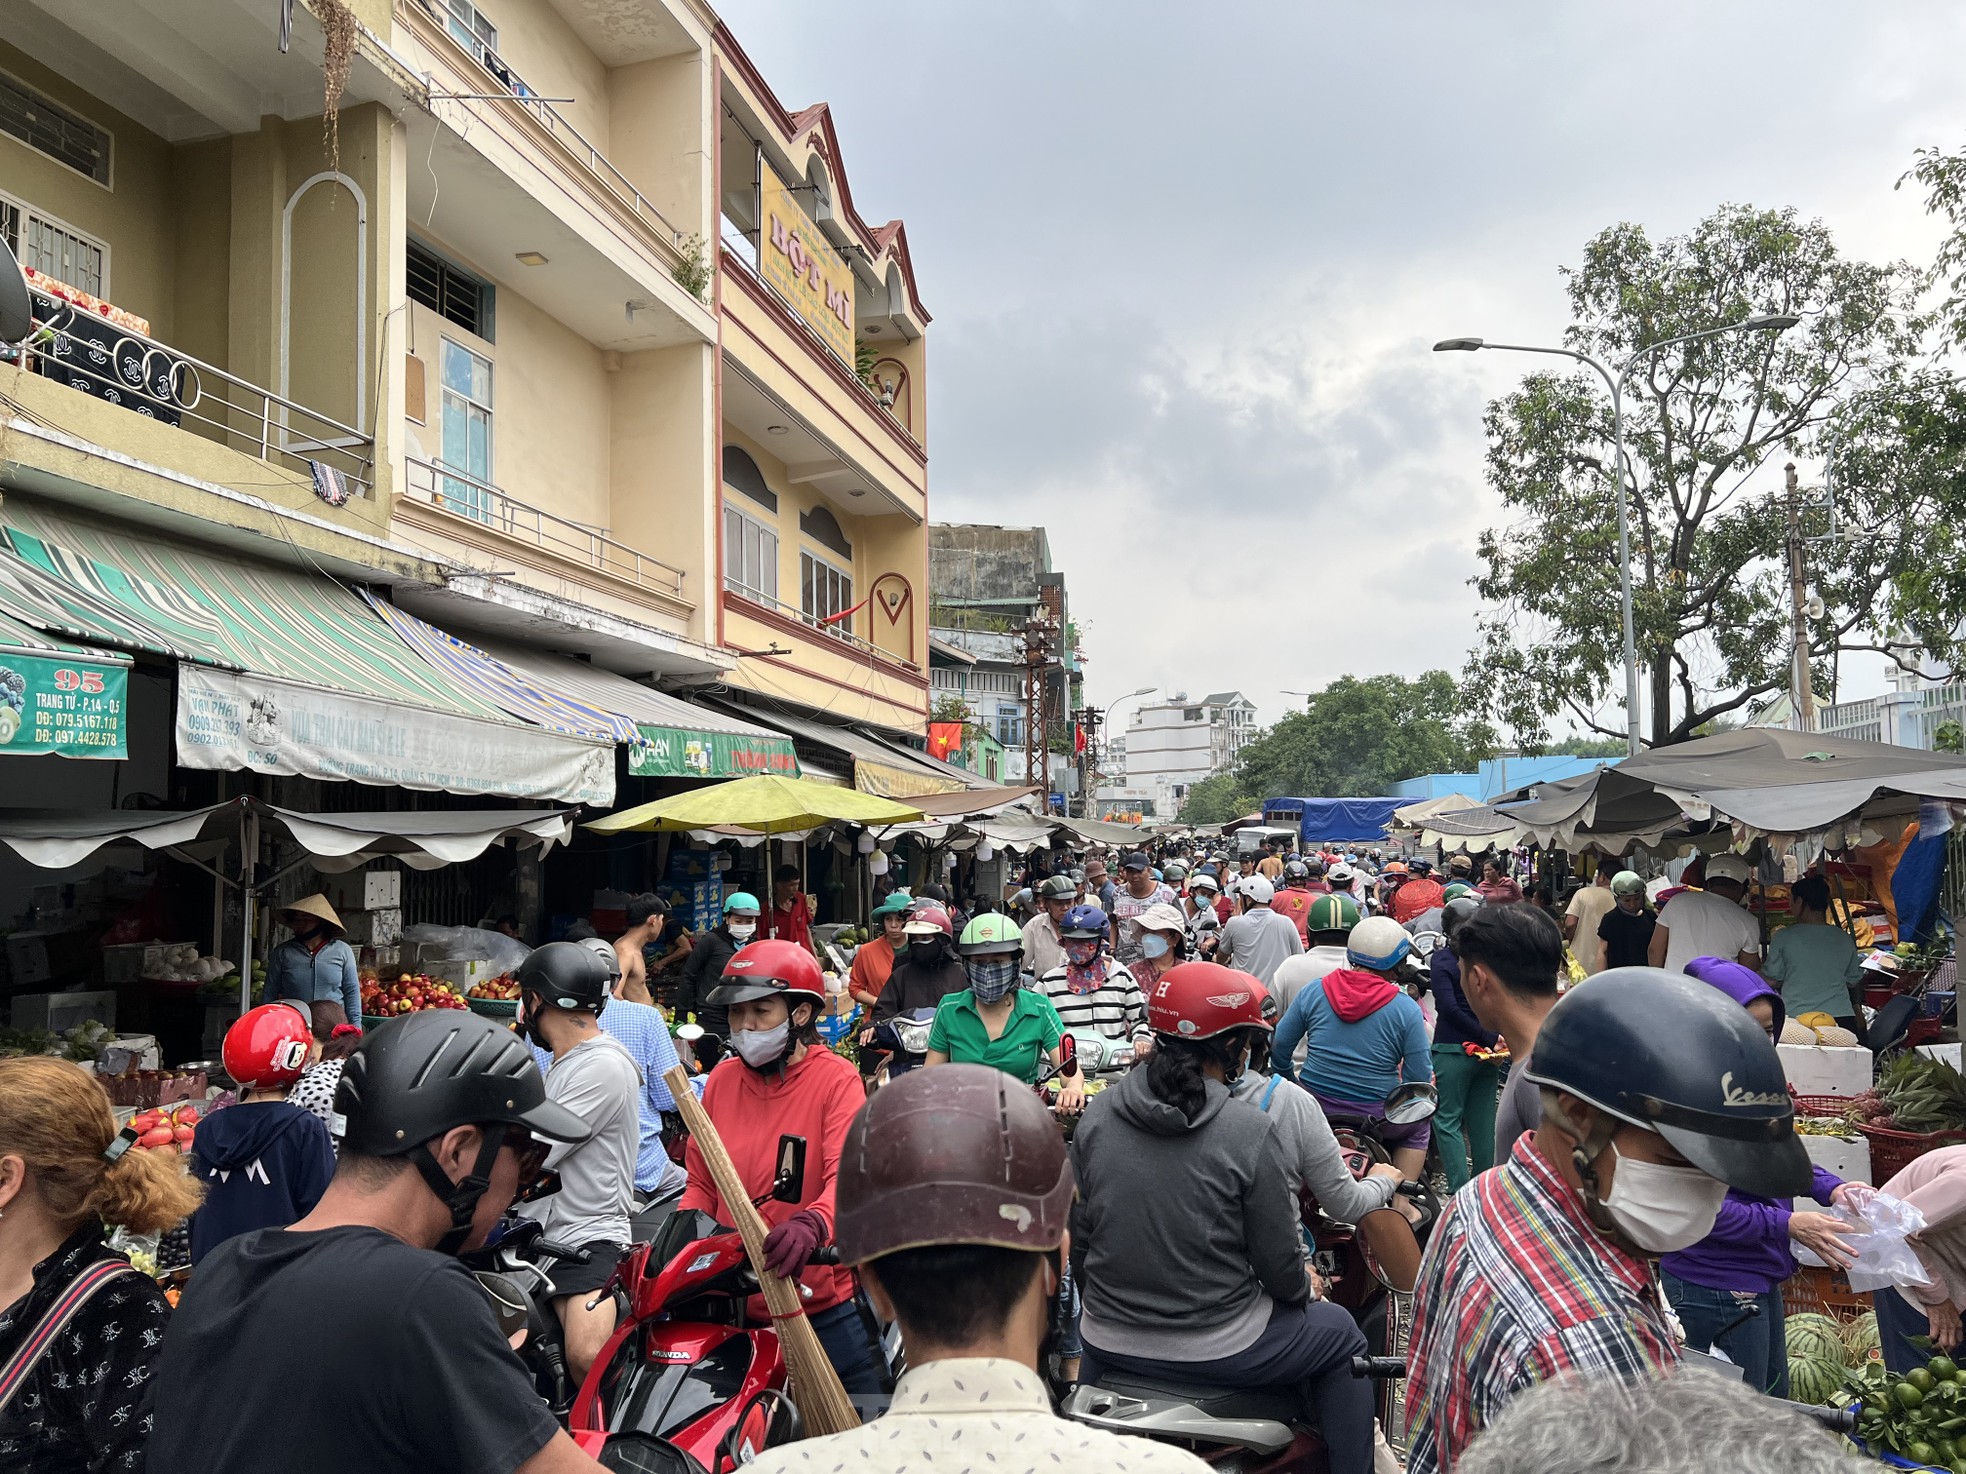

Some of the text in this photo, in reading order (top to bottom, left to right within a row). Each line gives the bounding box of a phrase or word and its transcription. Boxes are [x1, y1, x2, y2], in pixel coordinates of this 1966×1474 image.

[770, 212, 820, 293] BỘT
[825, 277, 850, 330] MÌ
[54, 669, 104, 694] 95
[36, 692, 63, 708] TRANG
[65, 691, 77, 710] TỬ
[83, 696, 102, 713] P.14
[109, 699, 120, 714] Q.5
[36, 711, 117, 730] DĐ: 079.5167.118
[35, 728, 117, 747] DĐ: 097.4428.578
[345, 761, 369, 777] TRANG
[1156, 981, 1171, 998] H
[652, 1350, 691, 1359] HONDA
